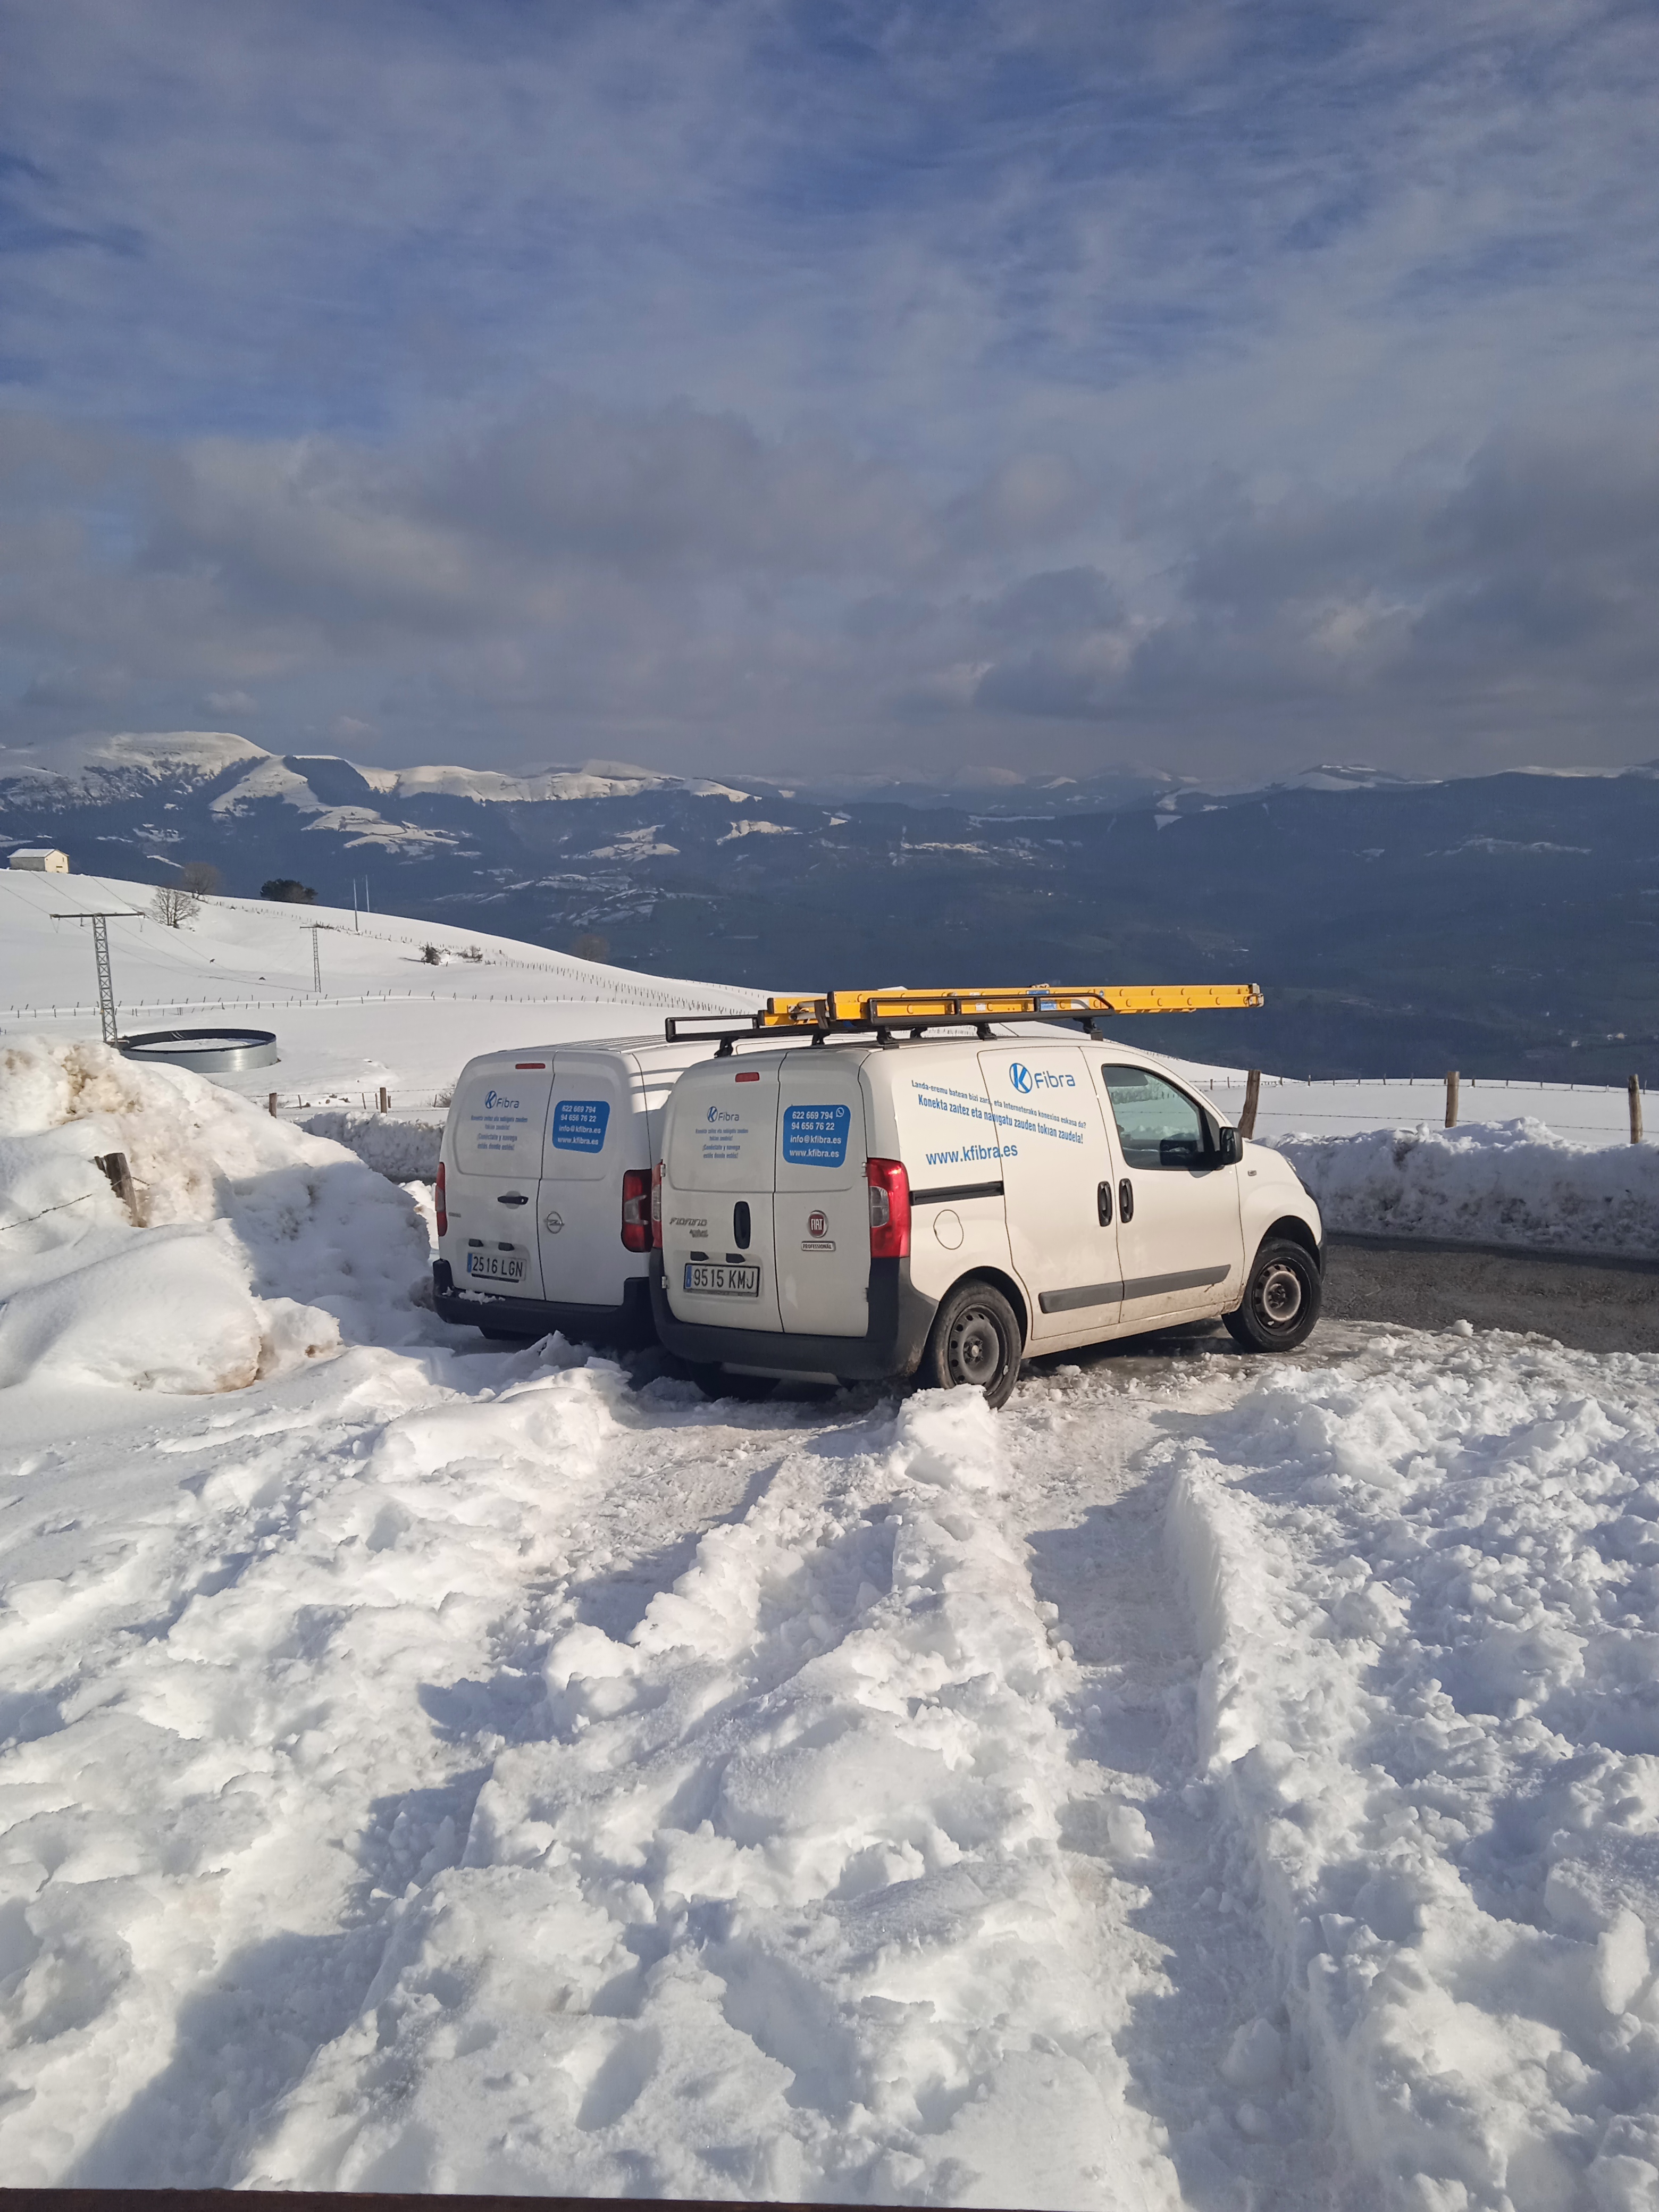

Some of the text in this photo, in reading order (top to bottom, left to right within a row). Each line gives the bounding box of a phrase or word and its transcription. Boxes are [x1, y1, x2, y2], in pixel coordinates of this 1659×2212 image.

[911, 1080, 948, 1094] Landa-eremu
[949, 1088, 967, 1099] batean
[1061, 1117, 1077, 1126] eskasa
[918, 1094, 1083, 1144] Konekta zaitez eta nabigatu zauden tokian zaudela!
[790, 1135, 841, 1144] info@kfibra.es
[790, 1149, 839, 1158] www.kfibra.es
[925, 1145, 1018, 1165] www.kfibra.es
[811, 1219, 823, 1230] FIAT
[473, 1256, 523, 1277] 2516 LGN
[694, 1269, 754, 1289] 9515 KMJ
